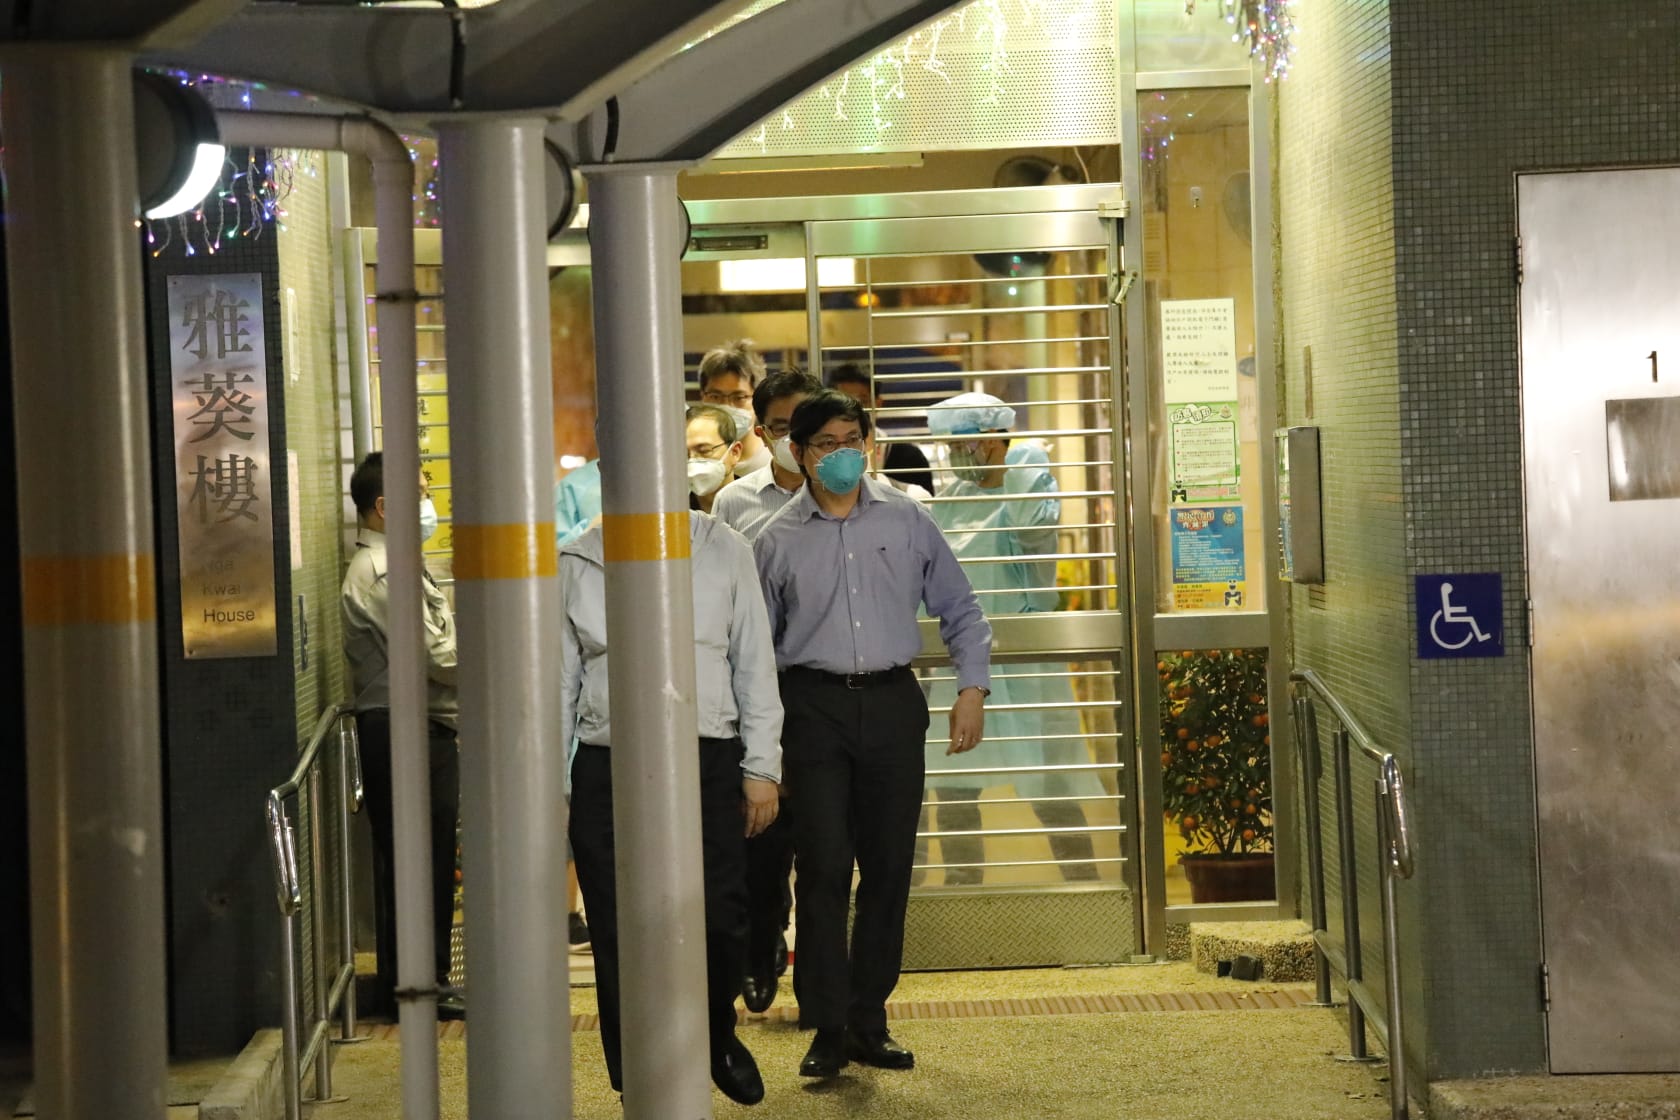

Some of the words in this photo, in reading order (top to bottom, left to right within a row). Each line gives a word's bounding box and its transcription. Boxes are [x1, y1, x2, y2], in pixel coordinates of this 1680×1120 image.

[1646, 350, 1658, 383] 1
[182, 288, 259, 524] 雅葵樓
[203, 608, 256, 623] House
